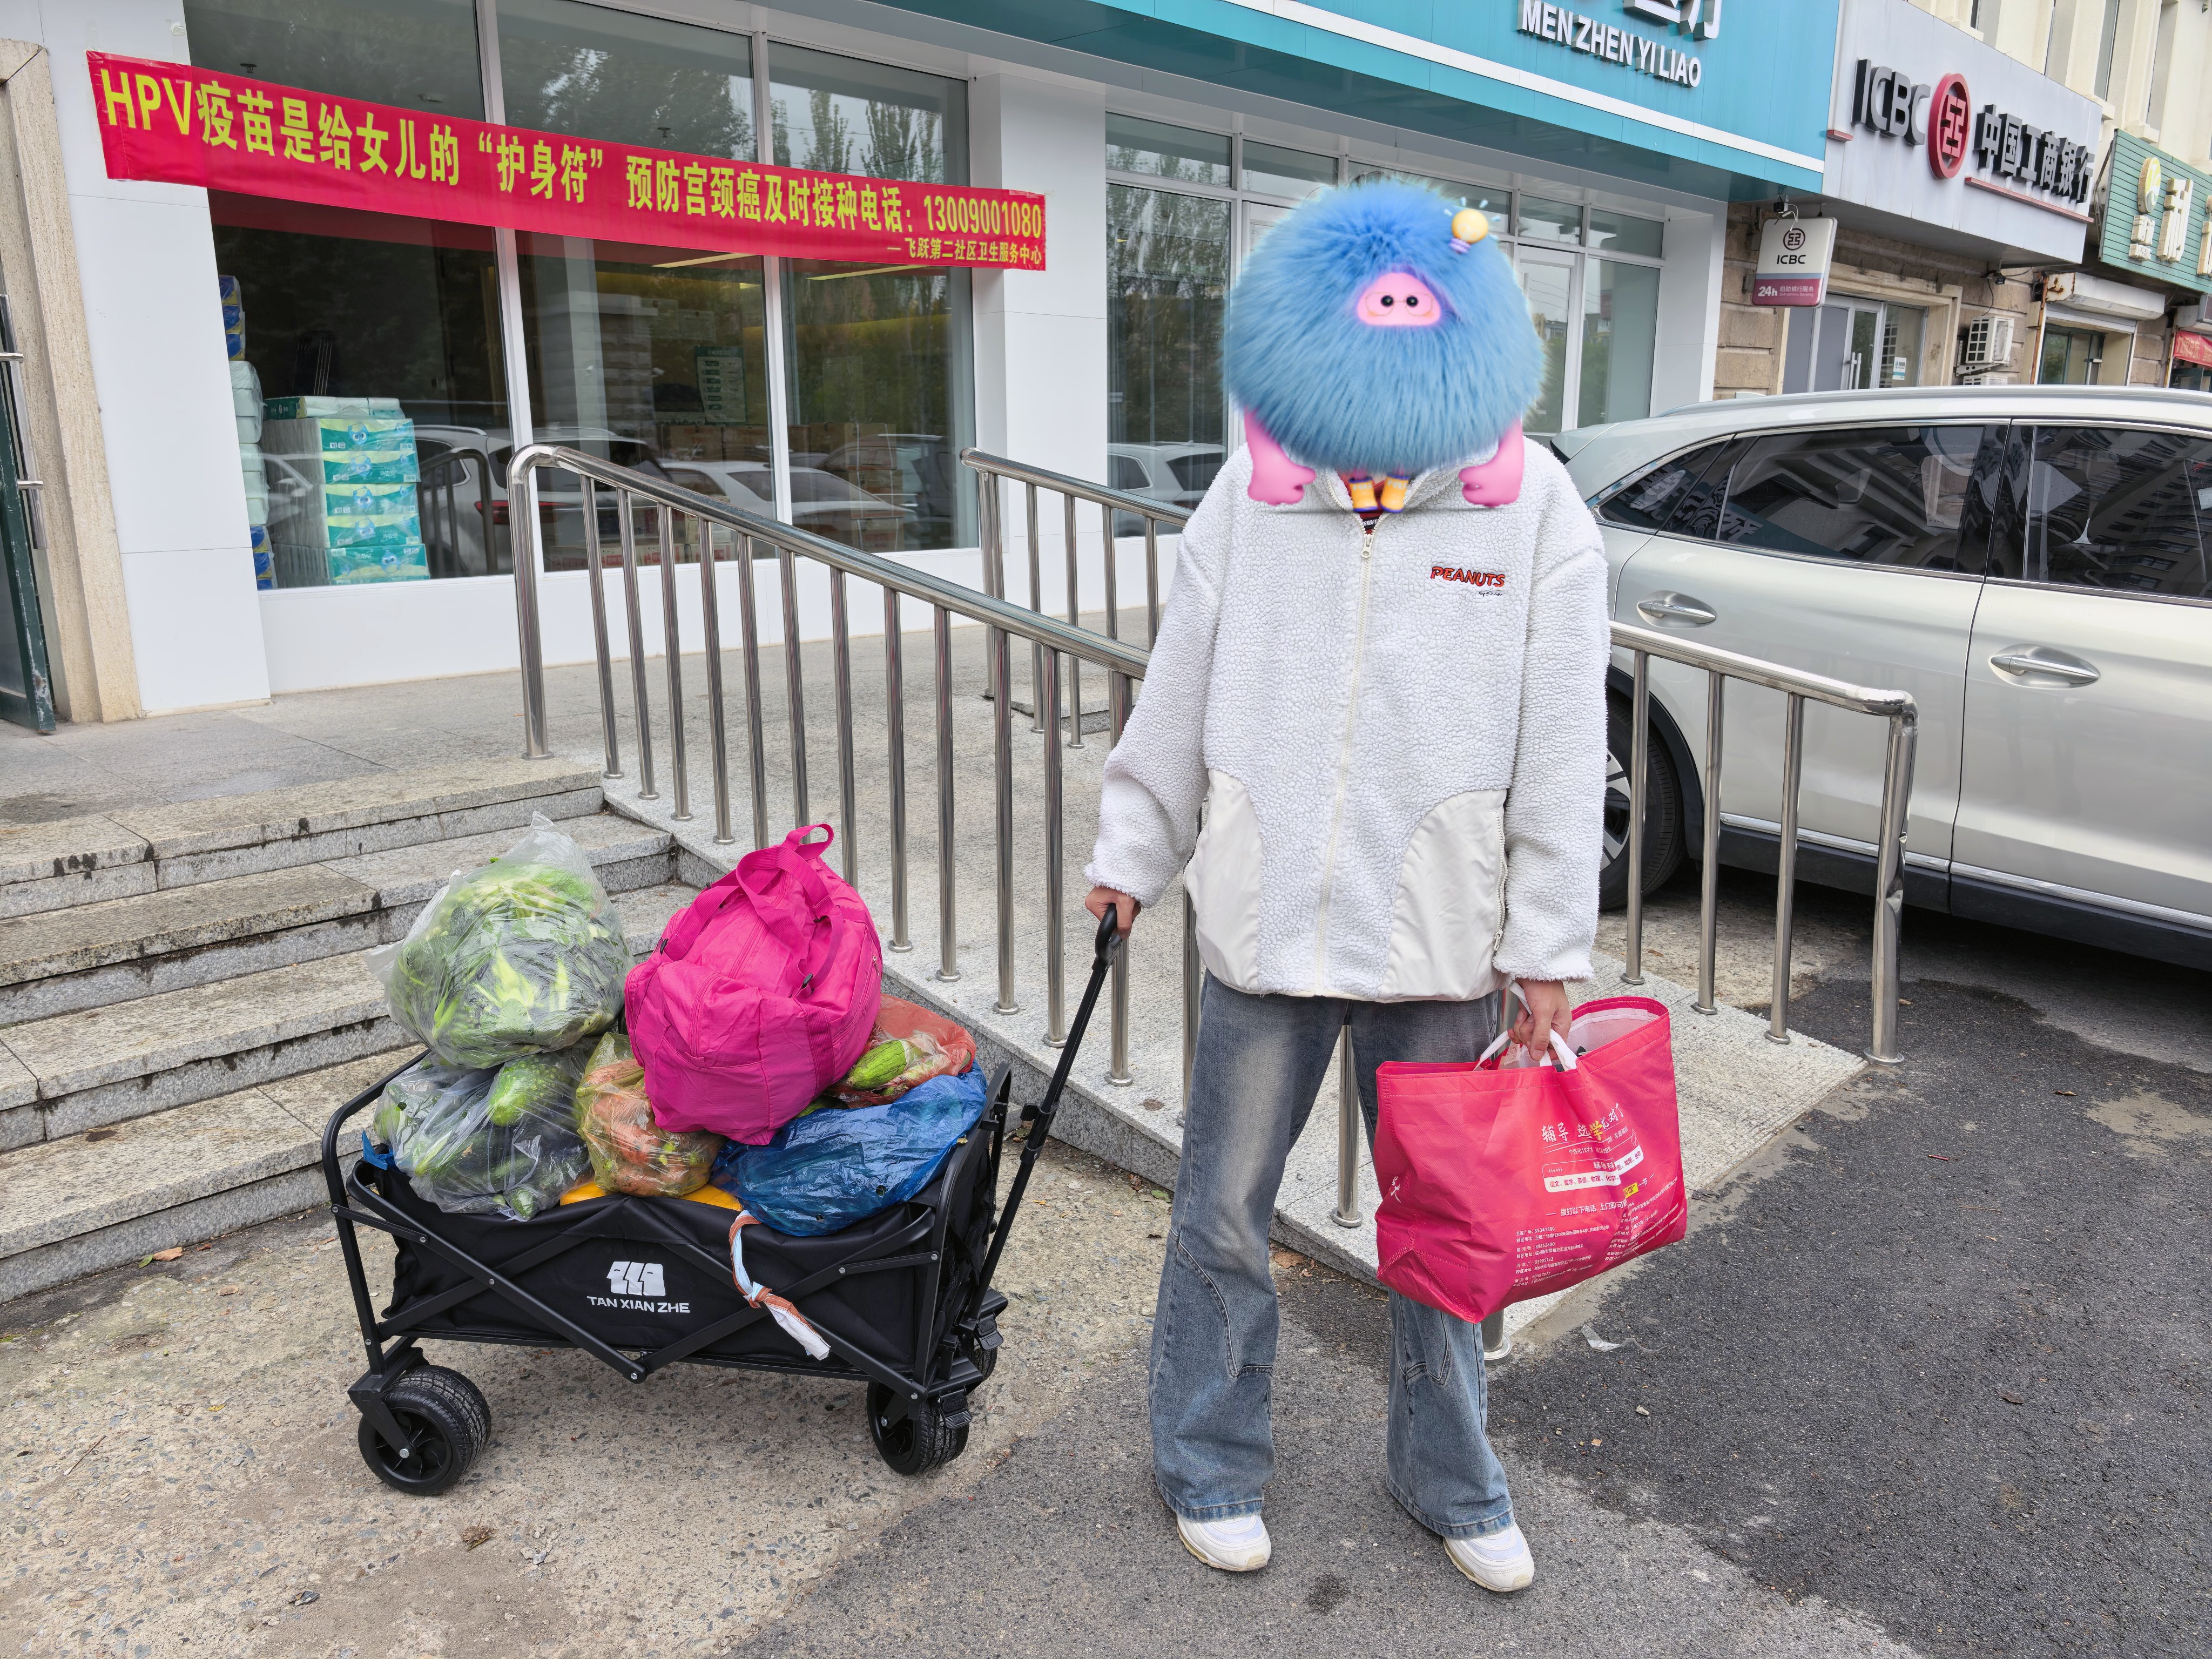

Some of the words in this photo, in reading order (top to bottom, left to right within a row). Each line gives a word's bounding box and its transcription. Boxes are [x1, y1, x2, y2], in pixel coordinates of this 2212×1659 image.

[1851, 59, 1931, 146] ICBC
[1973, 104, 2095, 203] 中国工商银行
[1777, 255, 1806, 265] ICBC
[1758, 286, 1778, 296] 24h
[1430, 566, 1506, 588] PEANUTS
[1541, 1122, 1569, 1143] 辅导
[1560, 1204, 1596, 1217] 拨打以下电话
[586, 1296, 618, 1308] TAN
[620, 1299, 655, 1312] XIAN
[657, 1302, 690, 1313] ZHE
